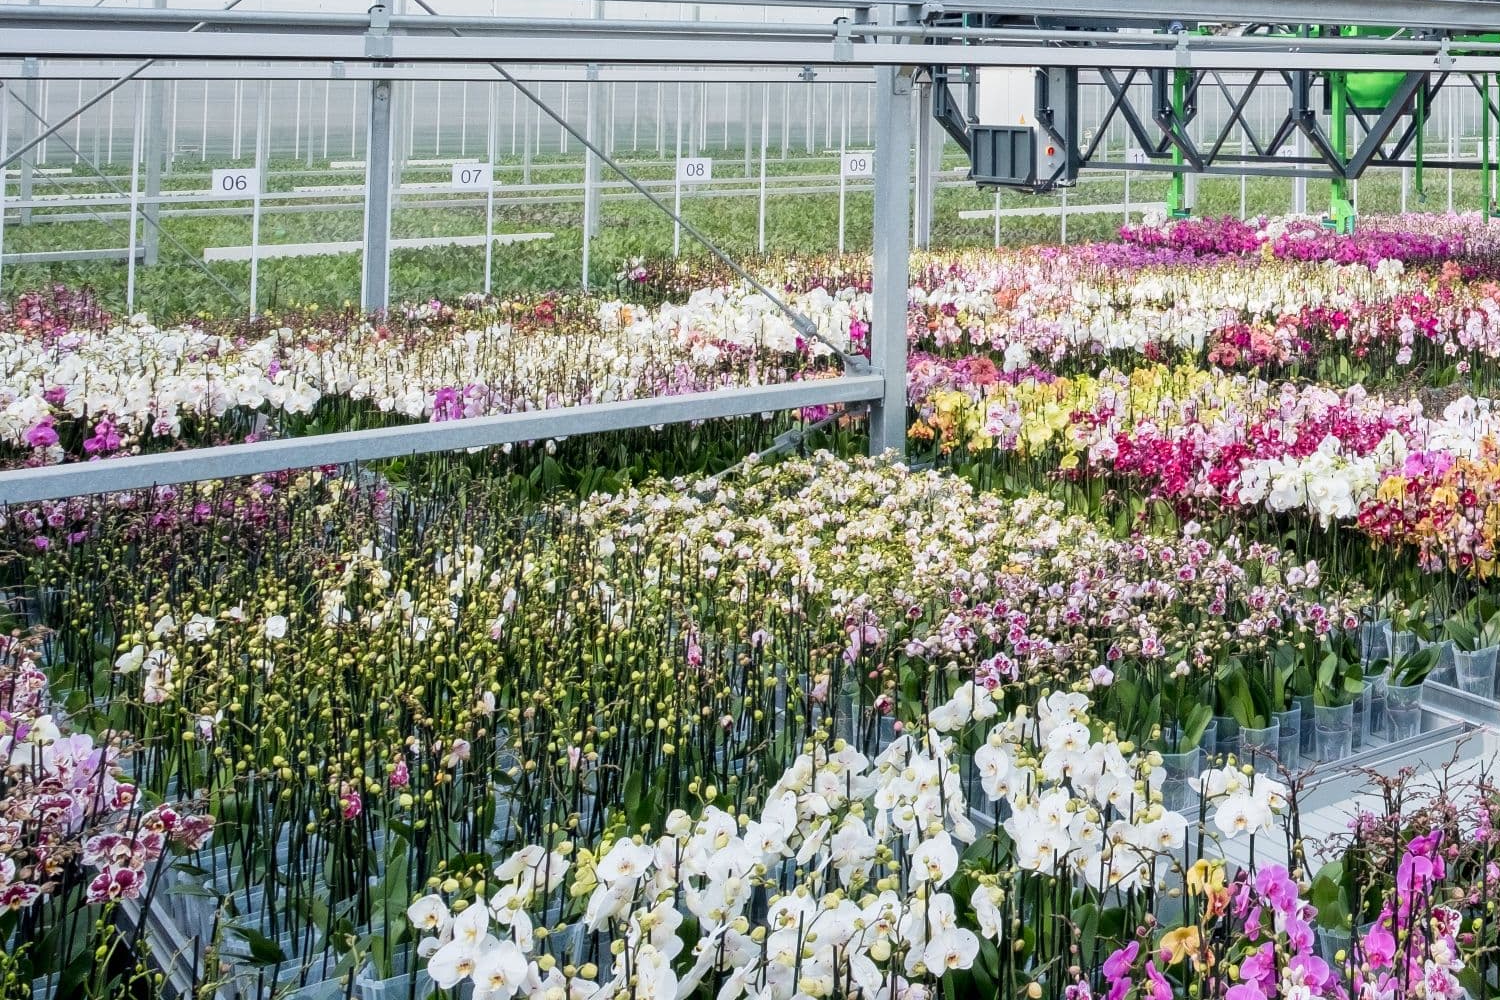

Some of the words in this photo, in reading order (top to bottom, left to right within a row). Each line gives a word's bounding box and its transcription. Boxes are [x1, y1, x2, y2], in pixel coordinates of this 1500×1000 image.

[686, 163, 705, 177] 08
[850, 158, 866, 171] 09
[222, 175, 247, 191] 06
[461, 169, 482, 184] 07
